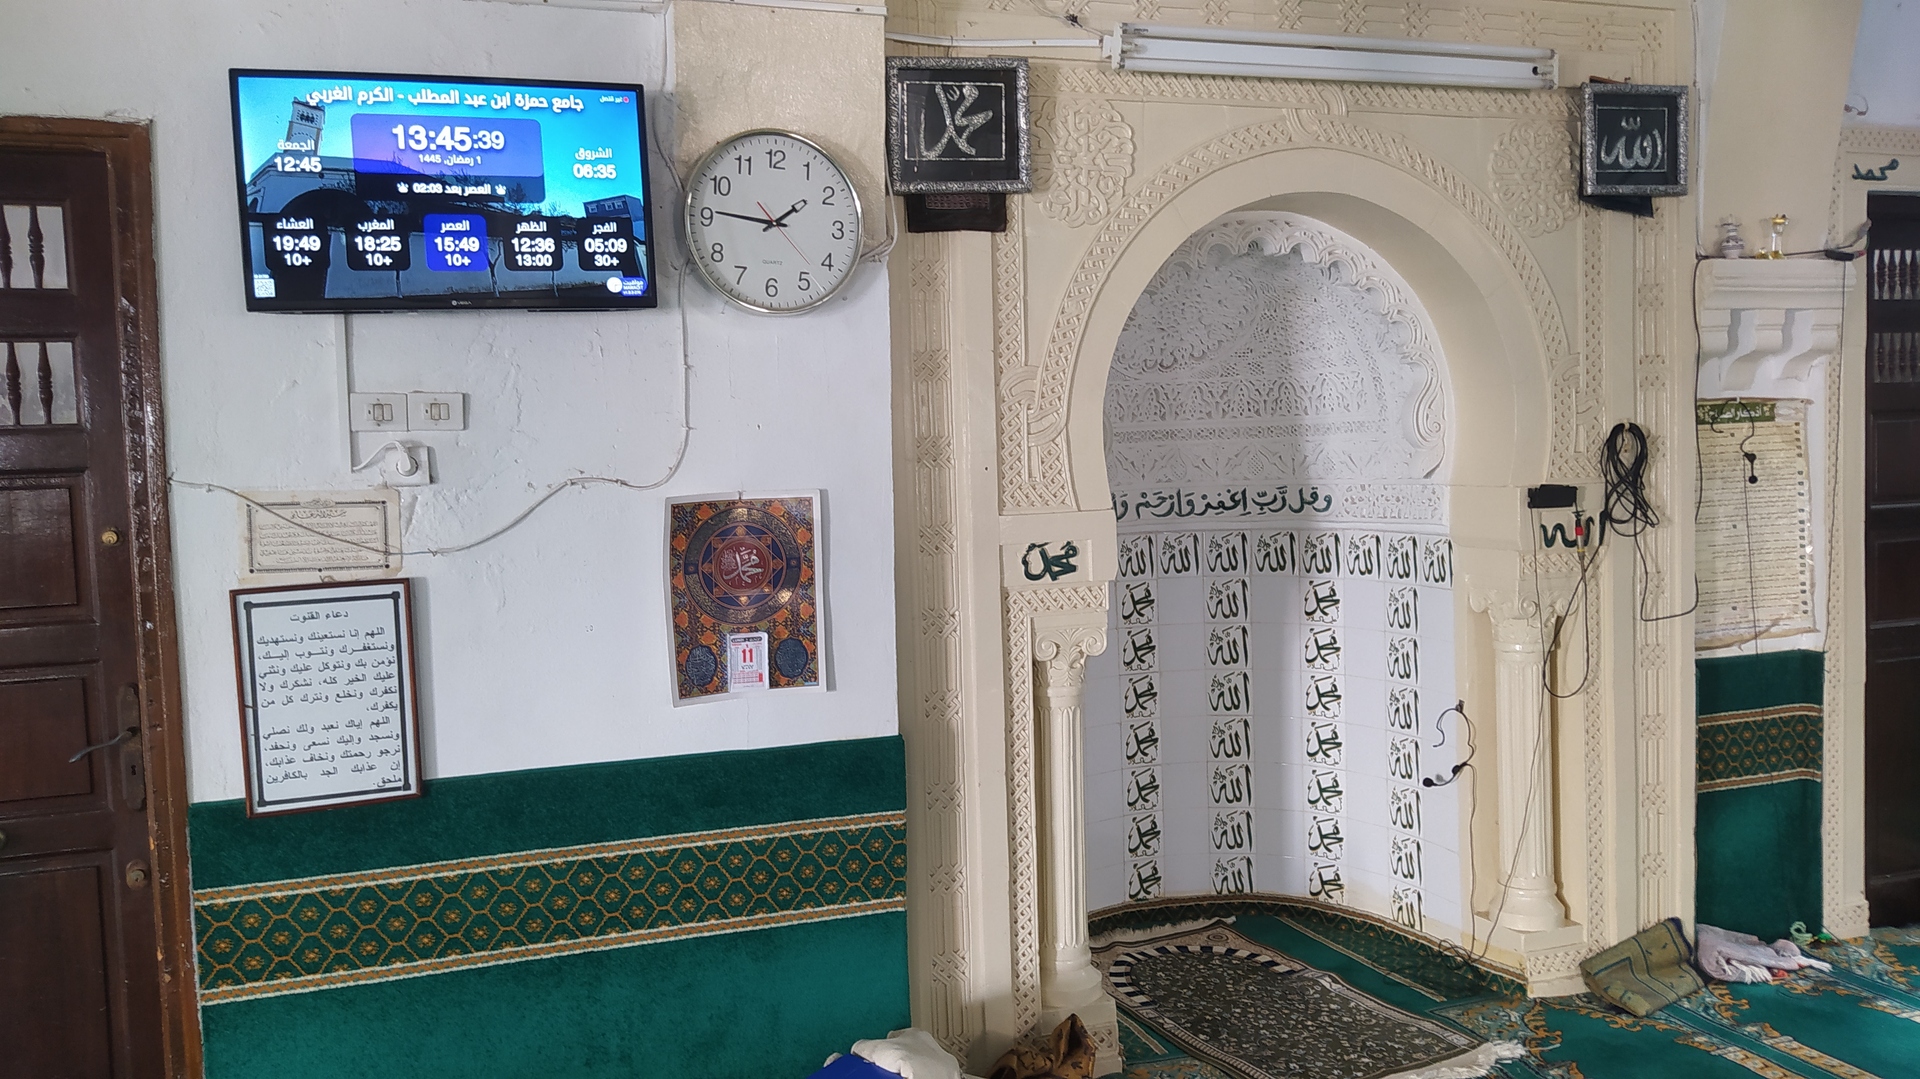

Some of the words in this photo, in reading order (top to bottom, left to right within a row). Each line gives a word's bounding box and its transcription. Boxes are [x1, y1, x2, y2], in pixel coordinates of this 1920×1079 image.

[306, 86, 353, 106] الغربي
[358, 86, 394, 106] الكرم
[408, 88, 460, 106] المطلب
[464, 93, 487, 108] عبد
[490, 92, 510, 110] ابن
[514, 92, 548, 110] حمزة
[552, 94, 584, 113] جامع
[277, 140, 315, 152] الجمعة
[392, 124, 505, 152] 13:45:39
[1601, 116, 1663, 170] الله
[418, 154, 442, 164] 1445
[476, 156, 482, 164] 1
[575, 147, 613, 160] الشروق
[765, 149, 786, 170] 12
[274, 156, 322, 172] 12:45
[572, 163, 616, 179] 06:35
[734, 154, 752, 176] 11
[802, 162, 810, 181] 1
[1852, 158, 1899, 181] محمد
[412, 182, 444, 194] 02:03
[444, 185, 462, 196] بعد
[463, 183, 492, 196] العصر
[710, 175, 732, 196] 10
[822, 186, 836, 206] 2
[276, 218, 314, 230] العشاء
[700, 207, 714, 227] 9
[358, 218, 395, 233] المغرب
[440, 220, 470, 234] العصر
[515, 220, 548, 234] الظهر
[592, 222, 617, 234] الفجر
[831, 220, 845, 240] 3
[272, 235, 322, 252] 19:49
[354, 236, 402, 252] 18:25
[434, 236, 480, 252] 15:49
[511, 238, 556, 252] 12:36
[584, 238, 628, 252] 05:09
[515, 254, 553, 266] 13:00
[710, 242, 724, 262] 8
[820, 252, 834, 272] 4
[734, 265, 748, 285] 7
[798, 272, 811, 291] 5
[765, 278, 778, 298] 6
[1118, 536, 1155, 577] الله
[1160, 533, 1199, 575] الله
[1207, 532, 1247, 574] الله
[1255, 532, 1295, 575] الله
[1302, 533, 1340, 576] الله
[1347, 535, 1381, 578] الله
[1387, 536, 1417, 582] الله
[1423, 539, 1453, 586] الله
[1122, 582, 1155, 618] محمد
[1207, 579, 1248, 620] الله
[1304, 580, 1340, 617] محمد
[290, 611, 320, 623] القنوت
[325, 610, 348, 620] دعاء
[1387, 588, 1418, 633] الله
[256, 633, 304, 646] ونستهديك
[308, 630, 345, 642] نستعينك
[349, 629, 360, 639] إنا
[364, 627, 385, 640] اللهم
[1123, 628, 1156, 665] محمد
[1207, 625, 1248, 667] الله
[1305, 628, 1341, 665] محمد
[355, 659, 367, 668] بك
[372, 656, 395, 668] نؤمن
[742, 648, 753, 663] 11
[1387, 638, 1418, 684] الله
[259, 666, 286, 679] ونثني
[290, 664, 312, 674] عليك
[318, 660, 350, 672] ونتوكل
[280, 678, 312, 690] نشكرك
[344, 674, 366, 686] الخير
[373, 672, 395, 682] عليك
[259, 682, 274, 692] ولا
[369, 686, 397, 698] نكفرك
[1125, 675, 1157, 712] محمد
[1208, 672, 1249, 713] الله
[1306, 676, 1341, 712] محمد
[261, 700, 275, 708] من
[282, 696, 294, 706] كل
[300, 693, 328, 704] ونترك
[335, 690, 363, 703] ونخلع
[1388, 688, 1419, 734] الله
[296, 724, 314, 734] ولك
[321, 722, 338, 732] نعبد
[345, 719, 362, 730] إياك
[370, 716, 390, 730] اللهم
[262, 726, 290, 740] نصلي
[336, 735, 362, 746] وإليك
[369, 731, 400, 742] ونسجد
[1126, 721, 1159, 758] محمد
[1210, 718, 1250, 760] الله
[1307, 722, 1342, 759] محمد
[303, 737, 330, 752] نسعى
[378, 745, 400, 757] نرجو
[302, 753, 335, 763] ونخاف
[340, 748, 372, 759] رحمتك
[1389, 738, 1419, 783] الله
[320, 767, 338, 778] الجد
[350, 762, 377, 774] عذابك
[390, 761, 400, 771] إن
[266, 770, 308, 784] بالكافرين
[1211, 764, 1251, 806] الله
[1127, 768, 1159, 805] محمد
[1308, 770, 1343, 806] محمد
[1390, 789, 1420, 834] الله
[1128, 814, 1161, 851] محمد
[1212, 810, 1252, 852] الله
[1309, 816, 1343, 855] محمد
[1390, 838, 1421, 884] الله
